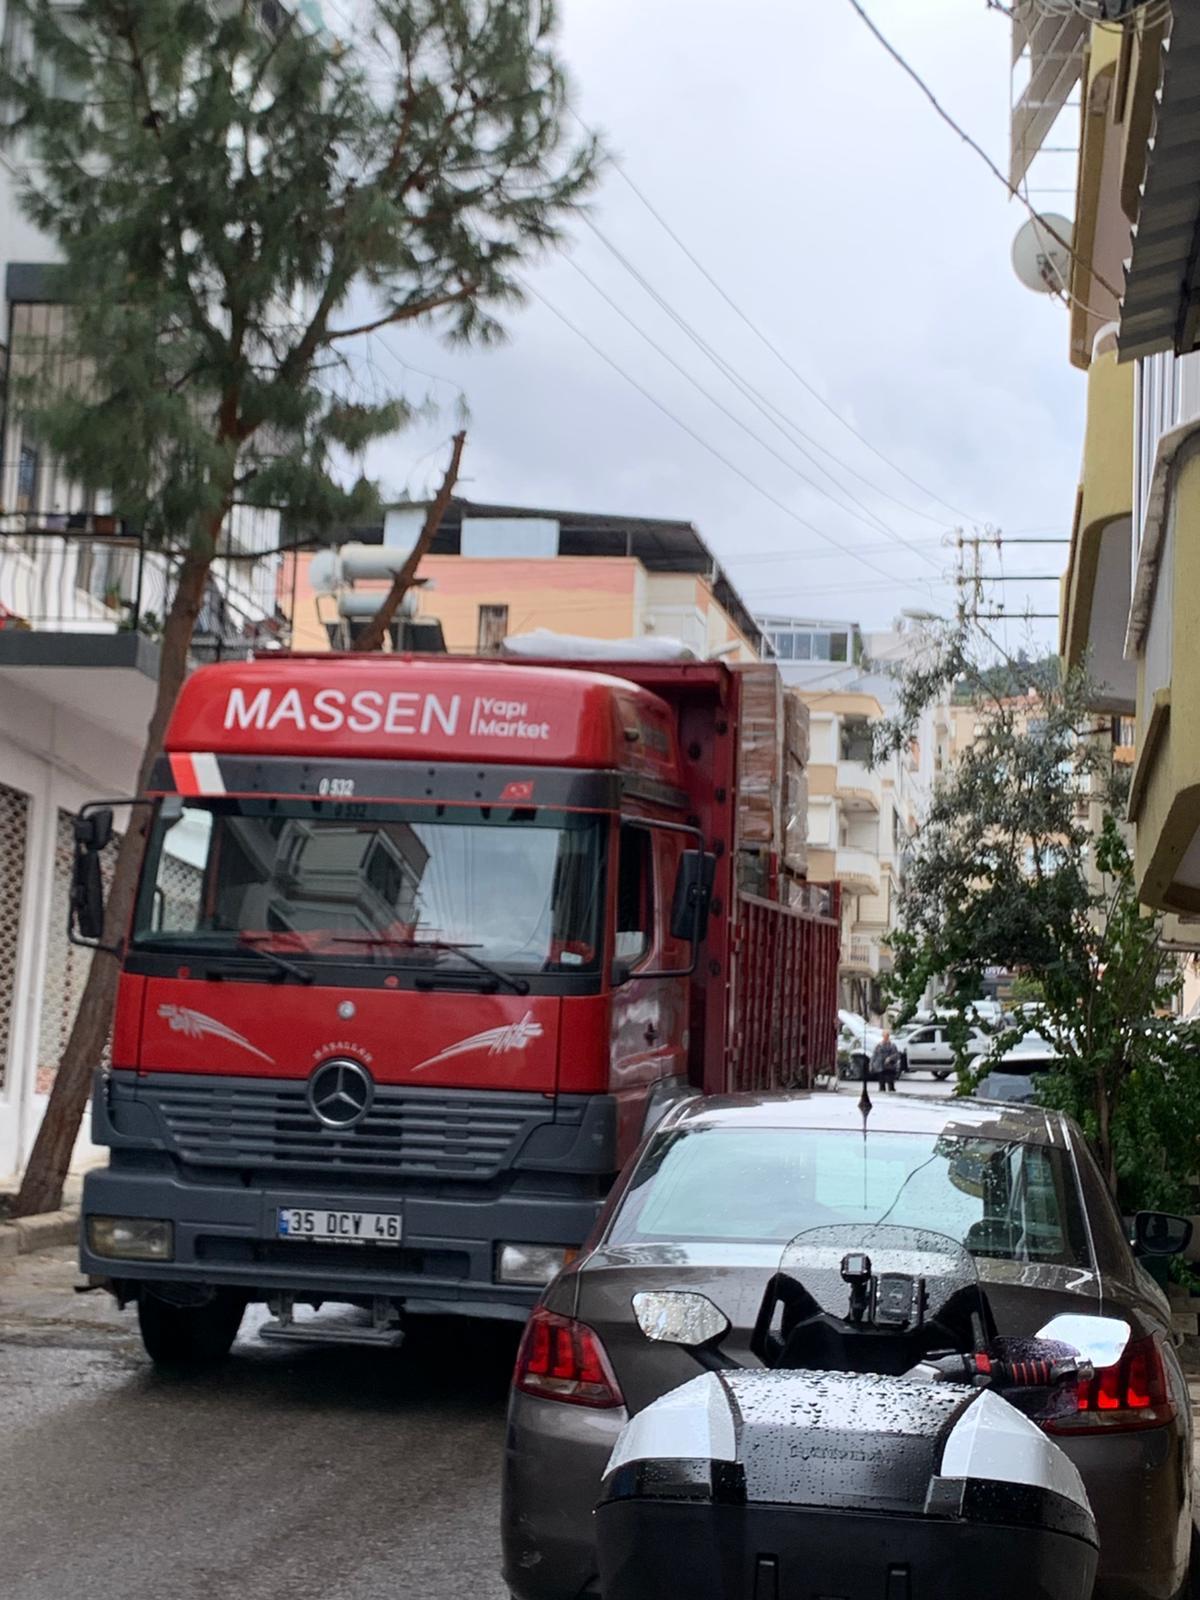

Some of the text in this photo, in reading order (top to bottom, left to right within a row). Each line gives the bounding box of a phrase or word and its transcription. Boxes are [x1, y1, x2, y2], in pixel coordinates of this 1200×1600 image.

[223, 687, 461, 736] MASSEN
[478, 718, 550, 739] Market
[291, 1211, 315, 1232] 35
[374, 1216, 398, 1237] 46
